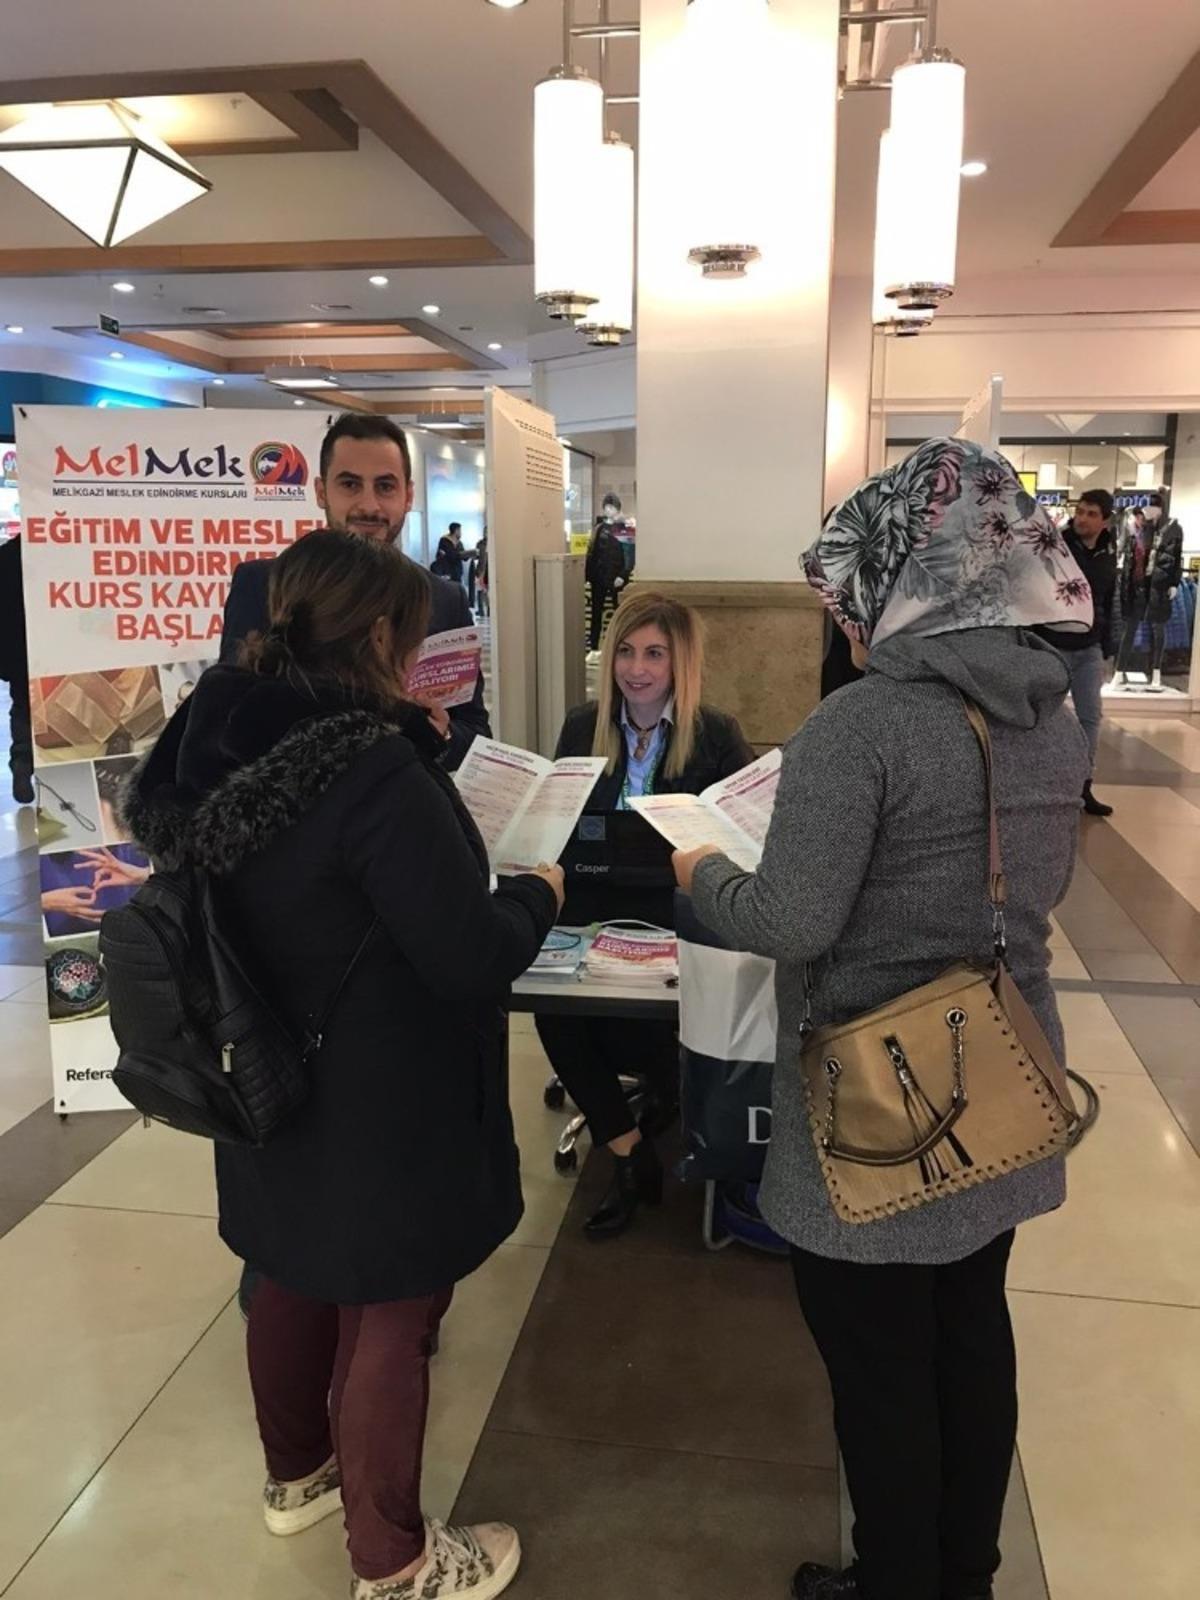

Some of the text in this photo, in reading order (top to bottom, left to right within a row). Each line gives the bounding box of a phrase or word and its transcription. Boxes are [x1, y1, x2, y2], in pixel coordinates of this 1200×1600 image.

[55, 443, 245, 478] MelMek
[53, 487, 247, 499] MELİKGAZİ MESLEK EDİNDİRME KURSLARI
[150, 519, 194, 545] VE
[203, 519, 327, 545] MESLE
[49, 582, 231, 608] KURS KAYI
[575, 863, 610, 874] Casper
